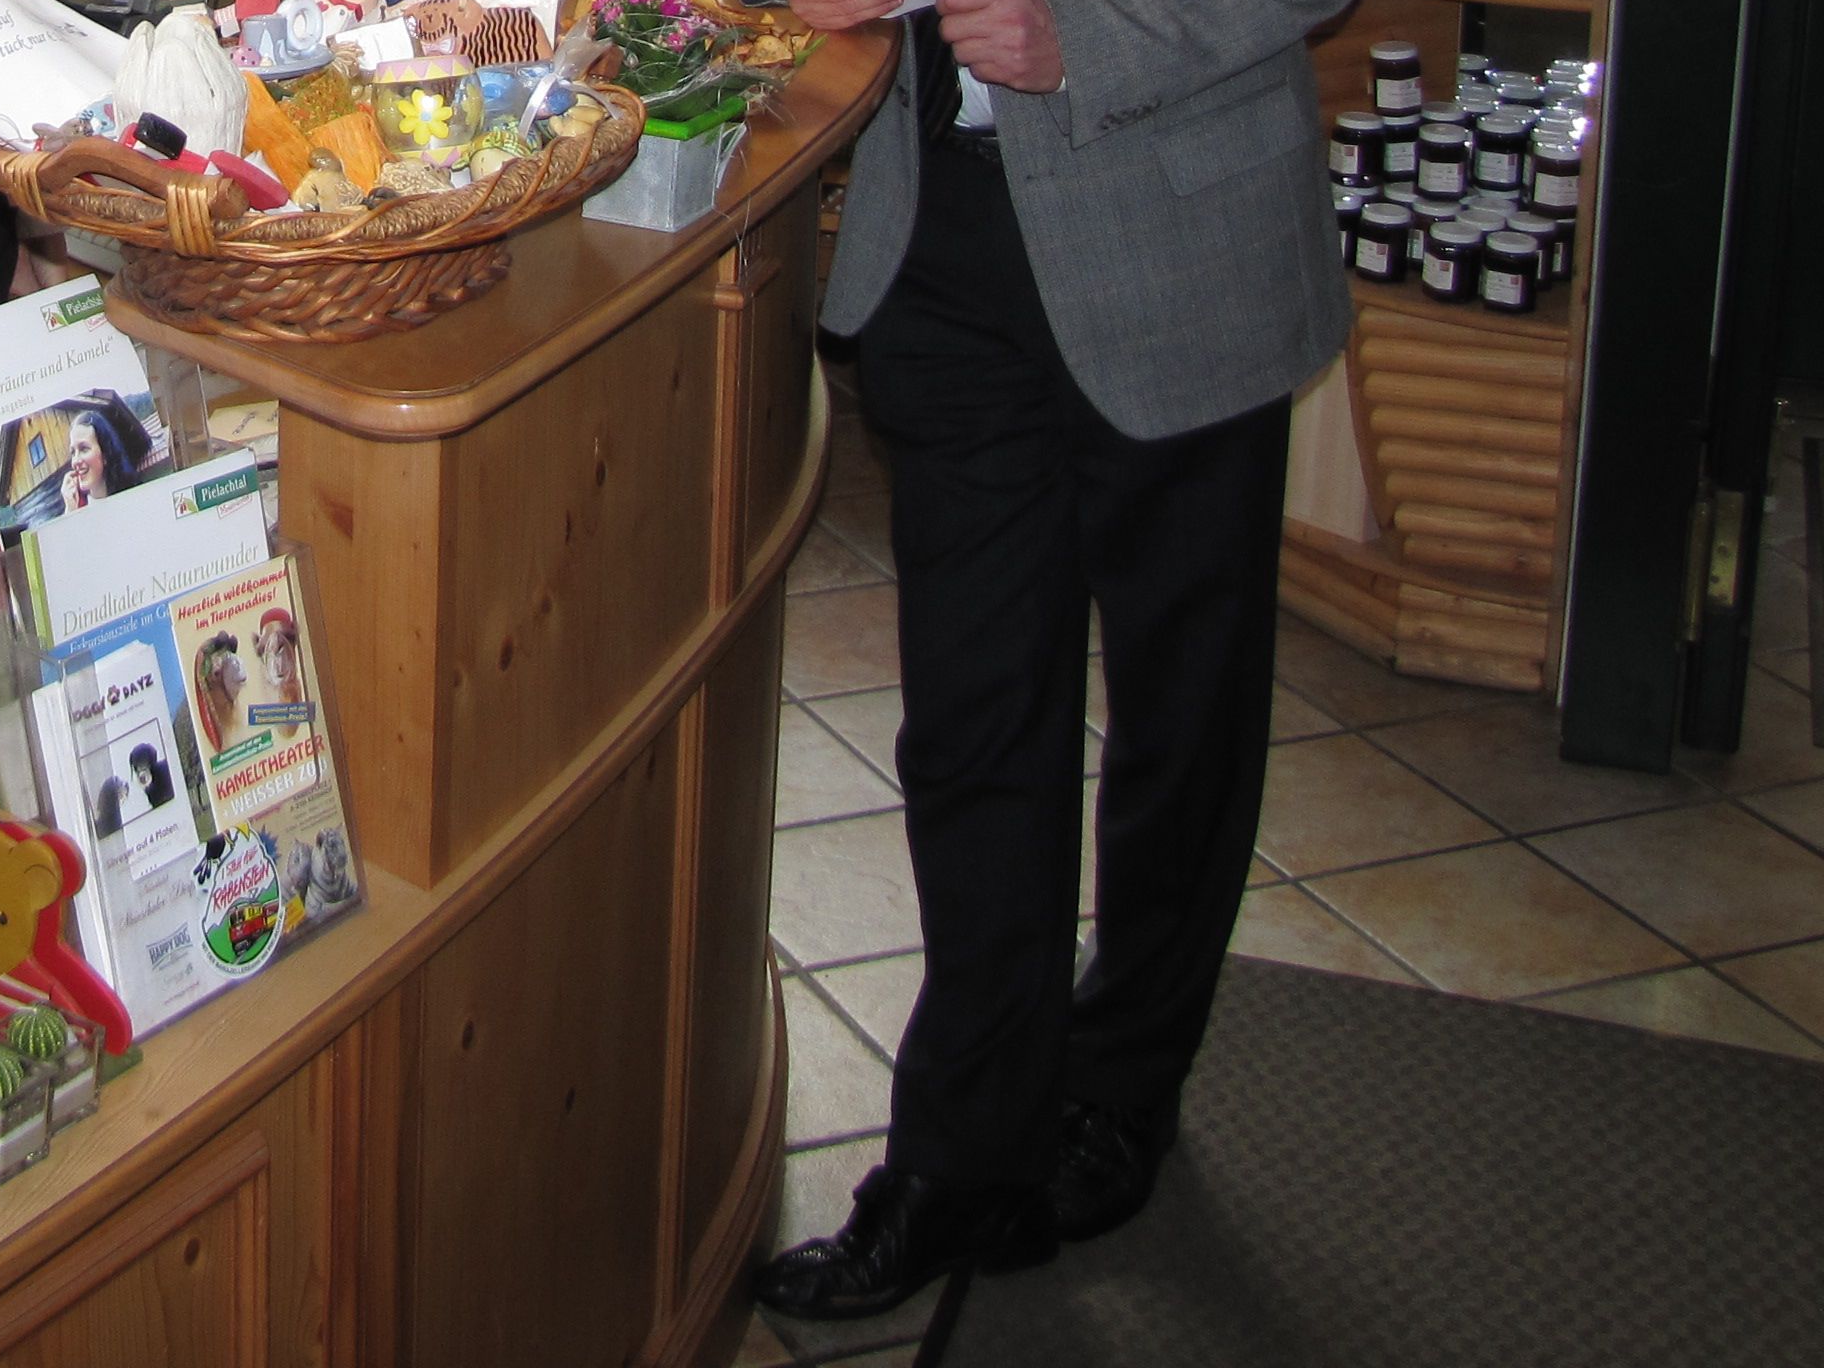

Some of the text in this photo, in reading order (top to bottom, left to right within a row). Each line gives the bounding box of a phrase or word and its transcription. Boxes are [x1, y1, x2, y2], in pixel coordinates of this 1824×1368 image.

[38, 354, 64, 378] und
[201, 474, 247, 503] Pielachtal
[62, 543, 260, 637] Dirndltaler Naturwunder
[178, 592, 222, 620] Herzlich
[196, 587, 277, 630] im Tierparadies!
[123, 673, 154, 699] DAYZ
[216, 735, 325, 800] KAMELTHEATER
[231, 773, 294, 815] WEISSER
[212, 860, 271, 912] RABENSTEIN
[148, 939, 175, 966] HAPPY
